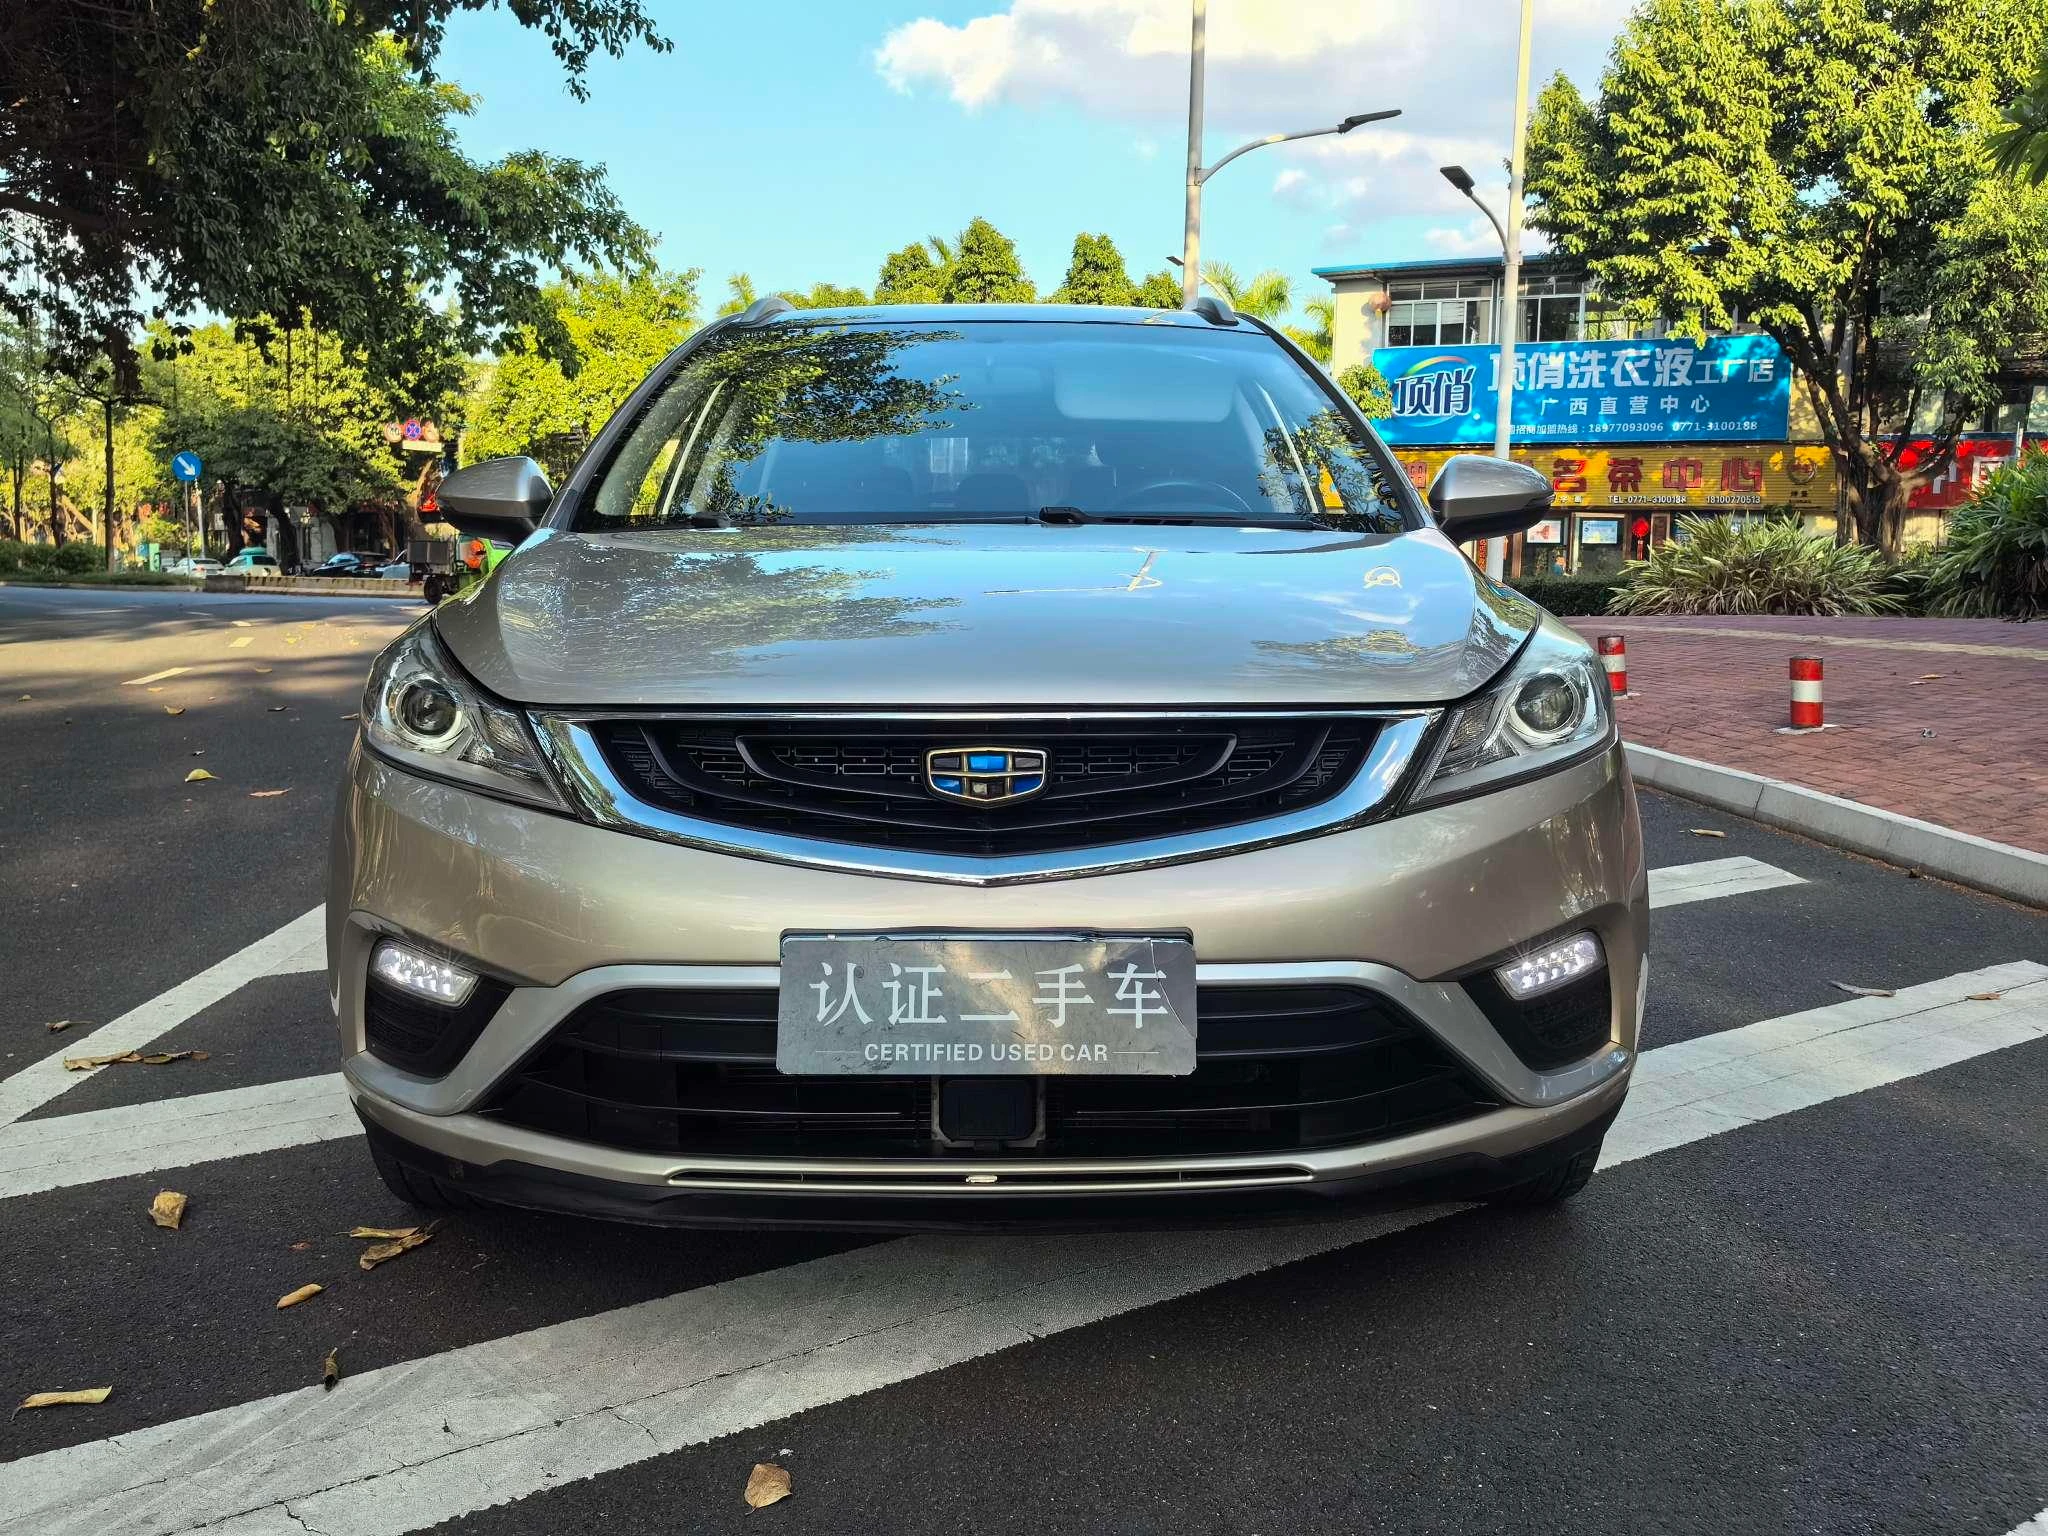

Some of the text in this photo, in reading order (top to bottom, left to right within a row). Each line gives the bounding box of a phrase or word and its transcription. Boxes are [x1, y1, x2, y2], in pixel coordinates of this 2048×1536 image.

[1394, 365, 1475, 416] 顶俏
[1541, 395, 1710, 416] 广西直营中心
[1588, 422, 1664, 433] 18977093096
[1672, 421, 1758, 431] 0771-3100188
[1513, 456, 1764, 493] 名茶中心
[809, 962, 1169, 1029] 认证二手车
[864, 1043, 1108, 1062] CERTIFIED USED CAR
